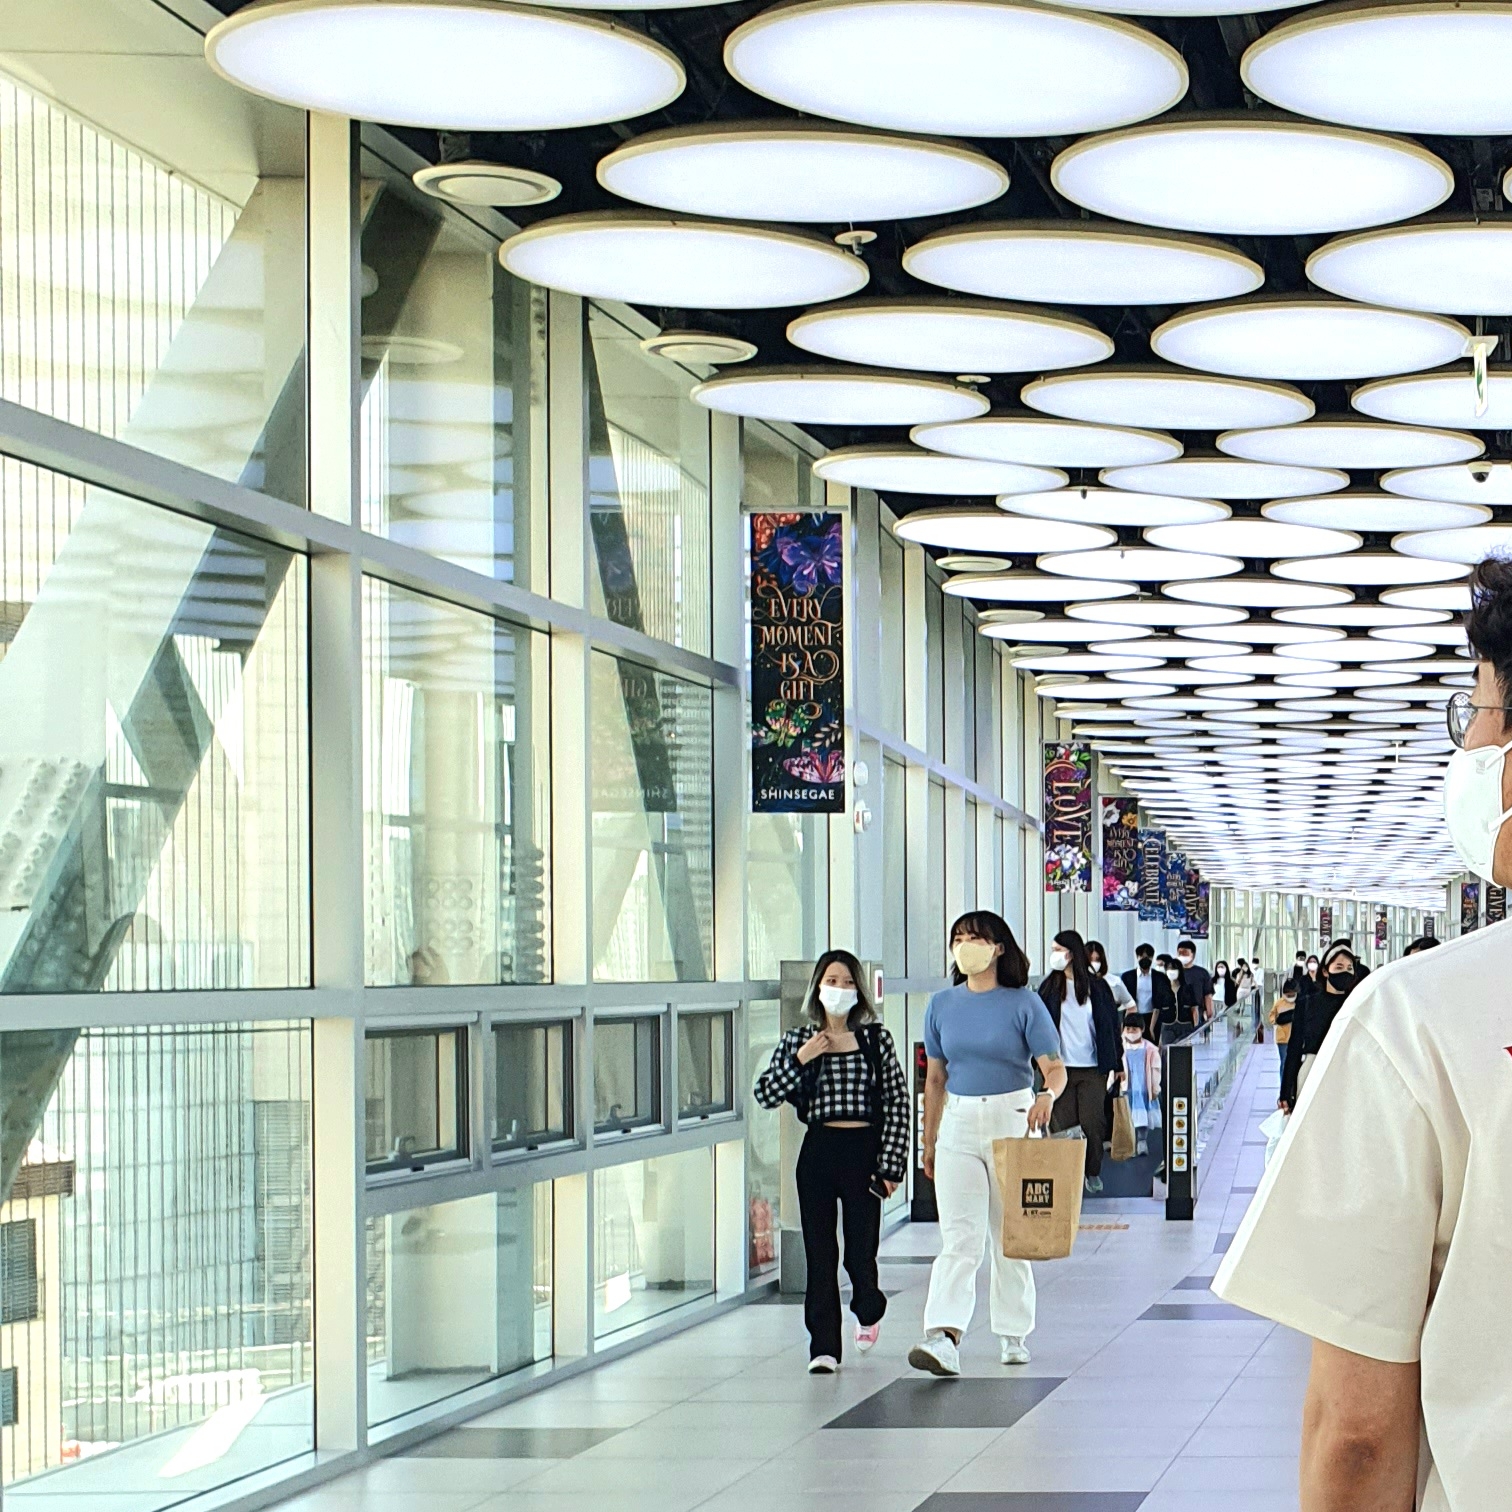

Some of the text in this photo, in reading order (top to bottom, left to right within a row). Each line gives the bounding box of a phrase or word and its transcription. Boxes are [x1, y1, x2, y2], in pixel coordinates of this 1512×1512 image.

[760, 593, 832, 623] EVERY
[760, 620, 840, 648] MOMENT
[780, 652, 801, 679] IS
[780, 680, 815, 701] GIFT
[761, 788, 835, 800] SHINSEGAE
[1052, 780, 1087, 843] LOVE
